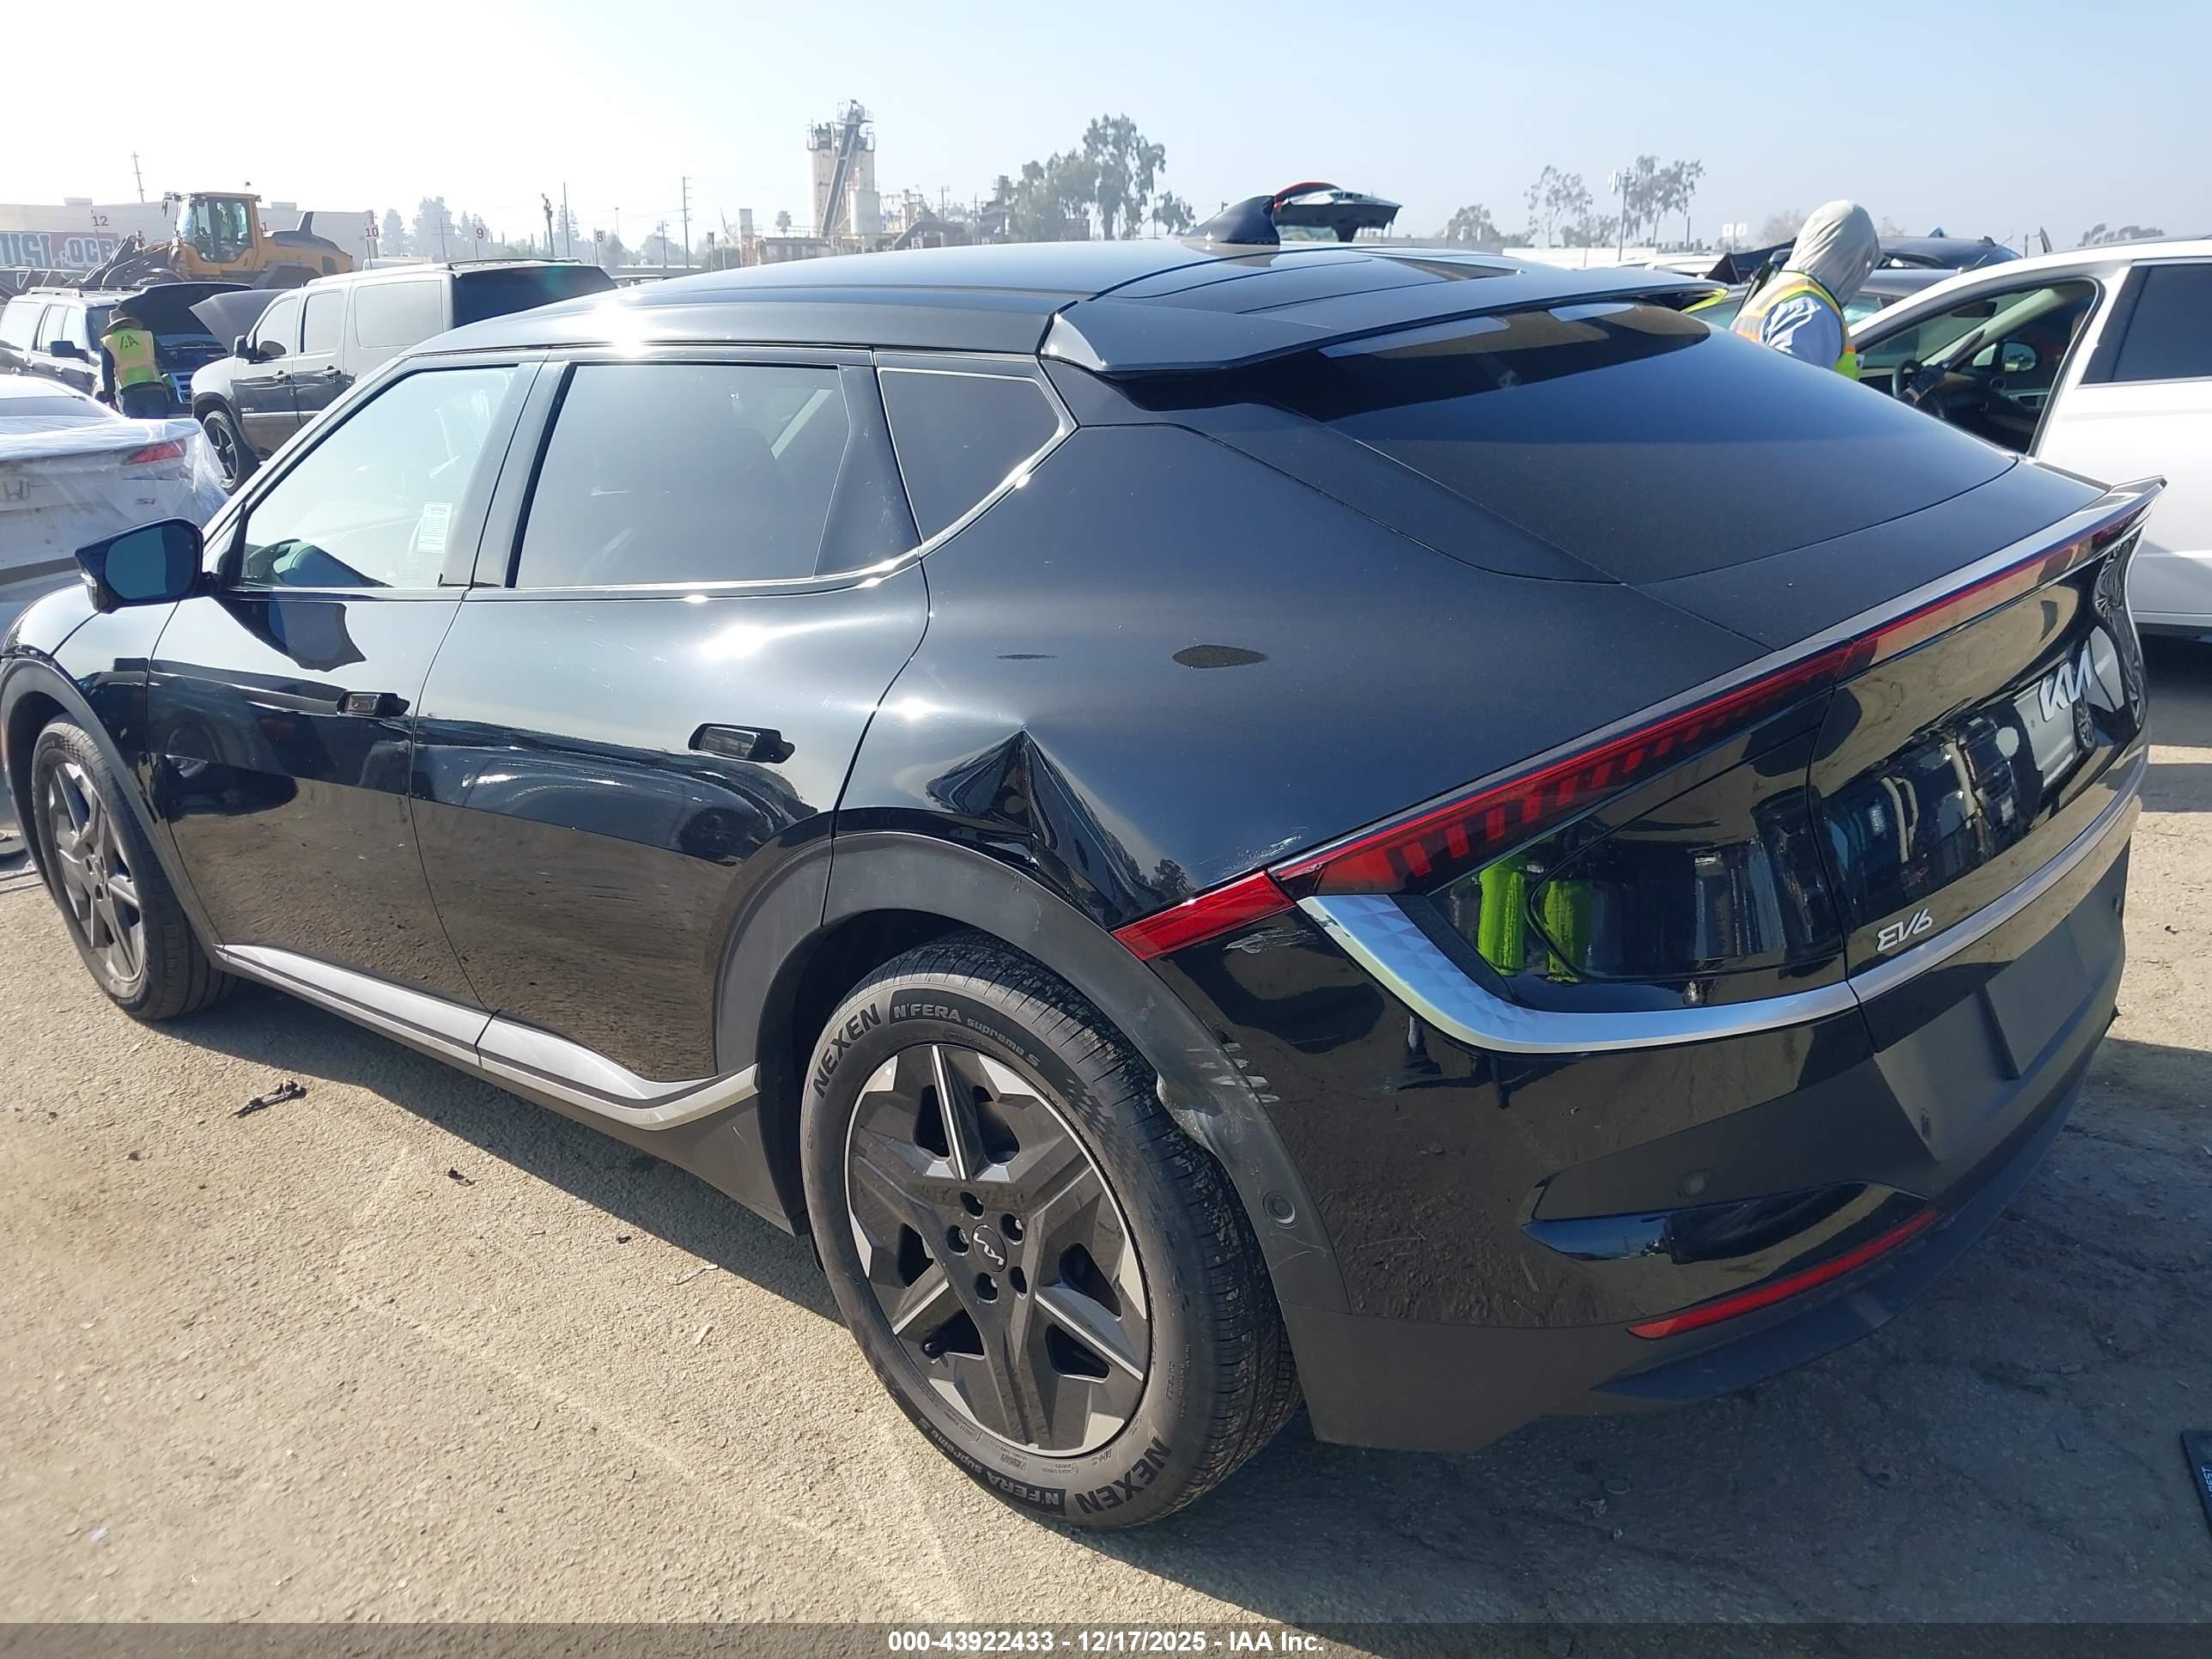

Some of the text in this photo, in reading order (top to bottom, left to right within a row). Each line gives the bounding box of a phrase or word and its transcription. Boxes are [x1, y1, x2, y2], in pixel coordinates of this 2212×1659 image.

[92, 216, 109, 227] 12
[365, 227, 379, 237] 10
[477, 228, 484, 239] 9
[2039, 648, 2092, 721] KIA
[1877, 908, 1933, 951] EV6
[812, 1003, 881, 1098] NEXEN
[894, 1003, 962, 1023] N'FERA
[1026, 1054, 1041, 1066] S
[986, 1470, 1060, 1505] N'FERA
[1074, 1436, 1172, 1515] NEXEN
